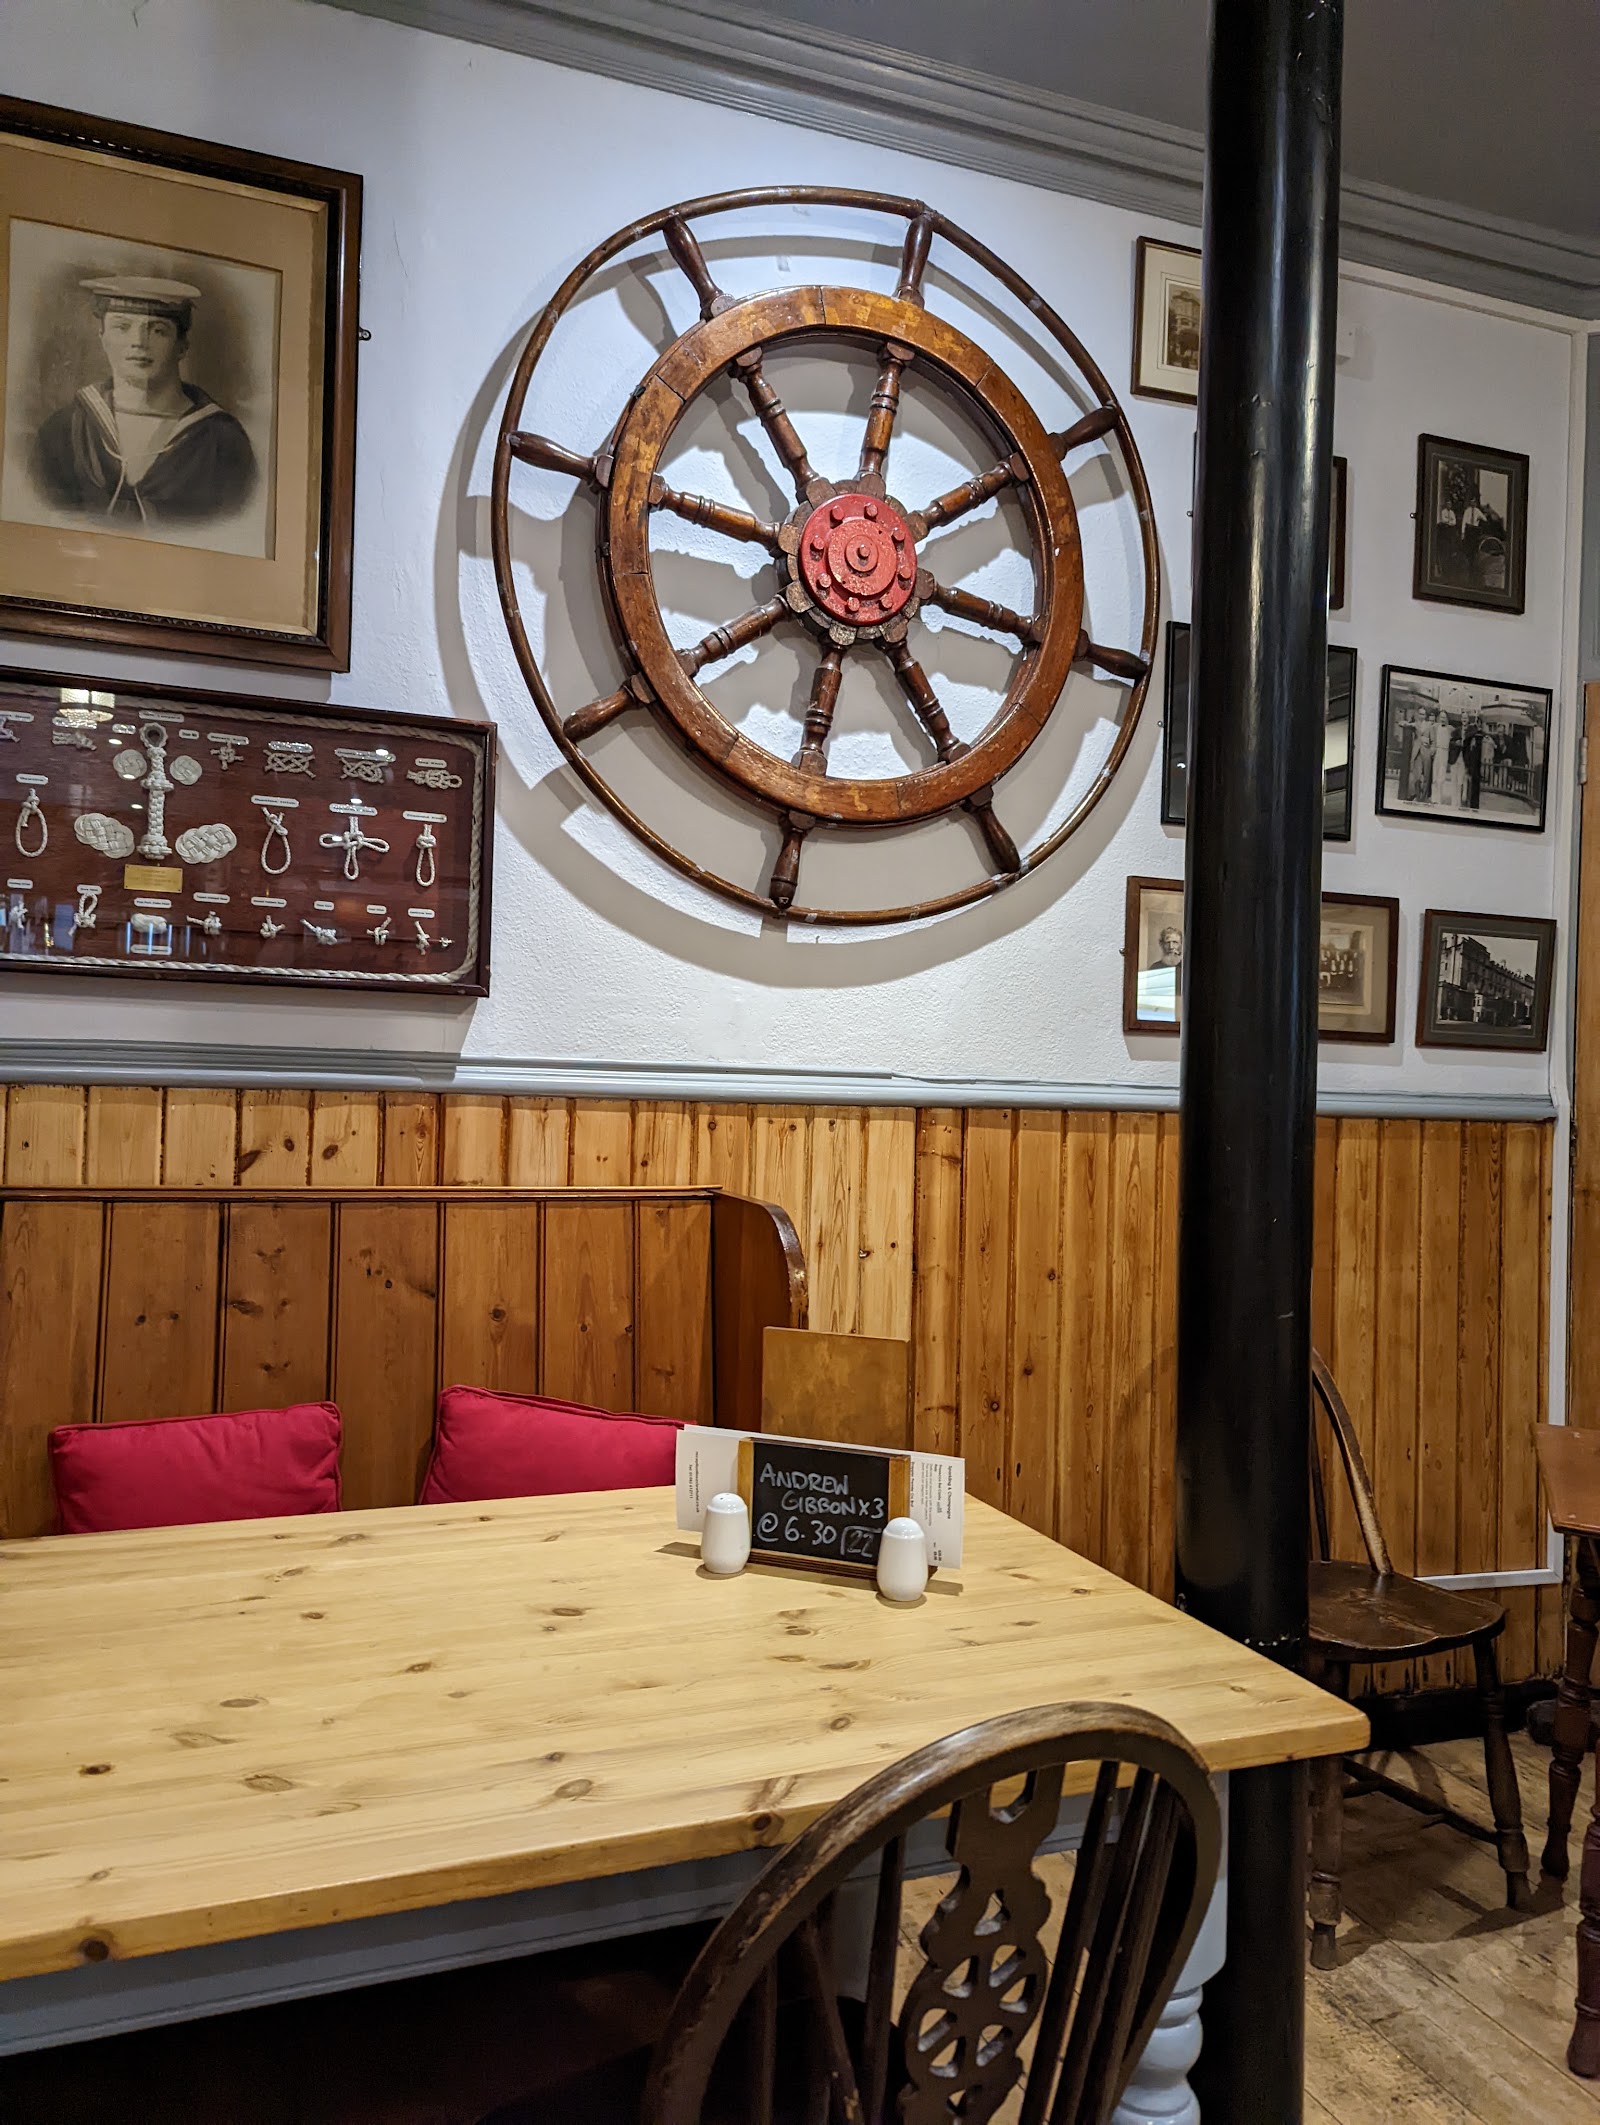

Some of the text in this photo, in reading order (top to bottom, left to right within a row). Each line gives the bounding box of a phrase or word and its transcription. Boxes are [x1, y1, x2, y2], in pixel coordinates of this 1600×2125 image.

[760, 1462, 849, 1495] ANDREW
[781, 1490, 856, 1515] GIBBON
[756, 1512, 779, 1542] @
[785, 1516, 837, 1545] 6.30
